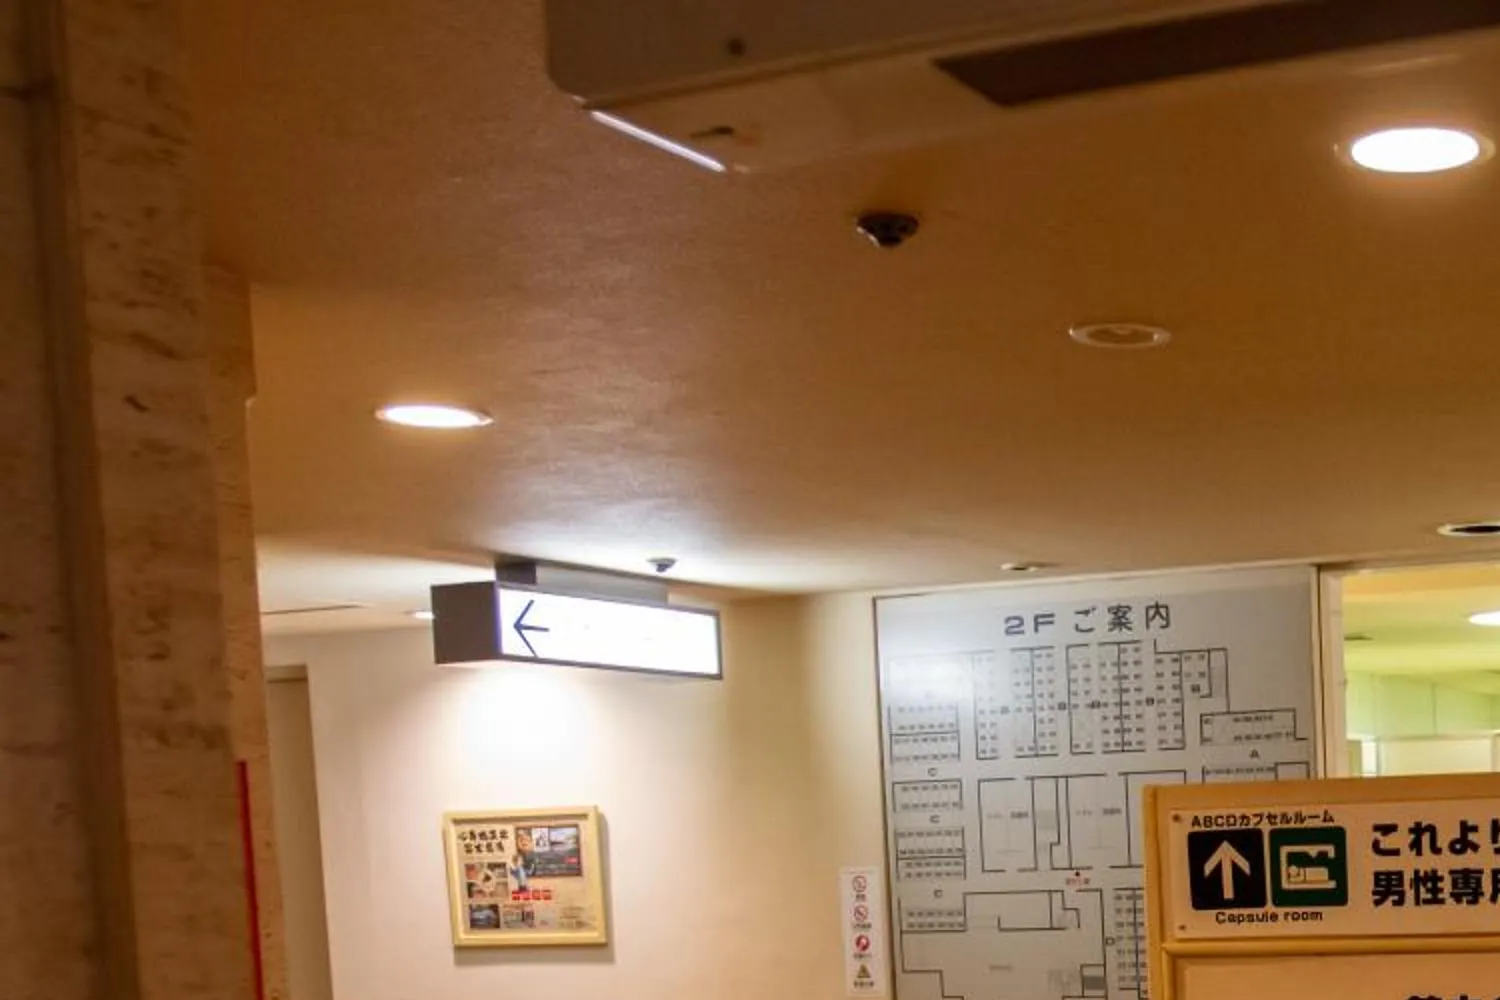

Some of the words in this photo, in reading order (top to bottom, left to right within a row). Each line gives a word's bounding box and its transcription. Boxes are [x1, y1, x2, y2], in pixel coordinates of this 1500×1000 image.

[1004, 612, 1056, 636] 2F
[1073, 601, 1171, 633] ご案内
[1215, 910, 1278, 925] Capsule
[1283, 911, 1323, 921] room
